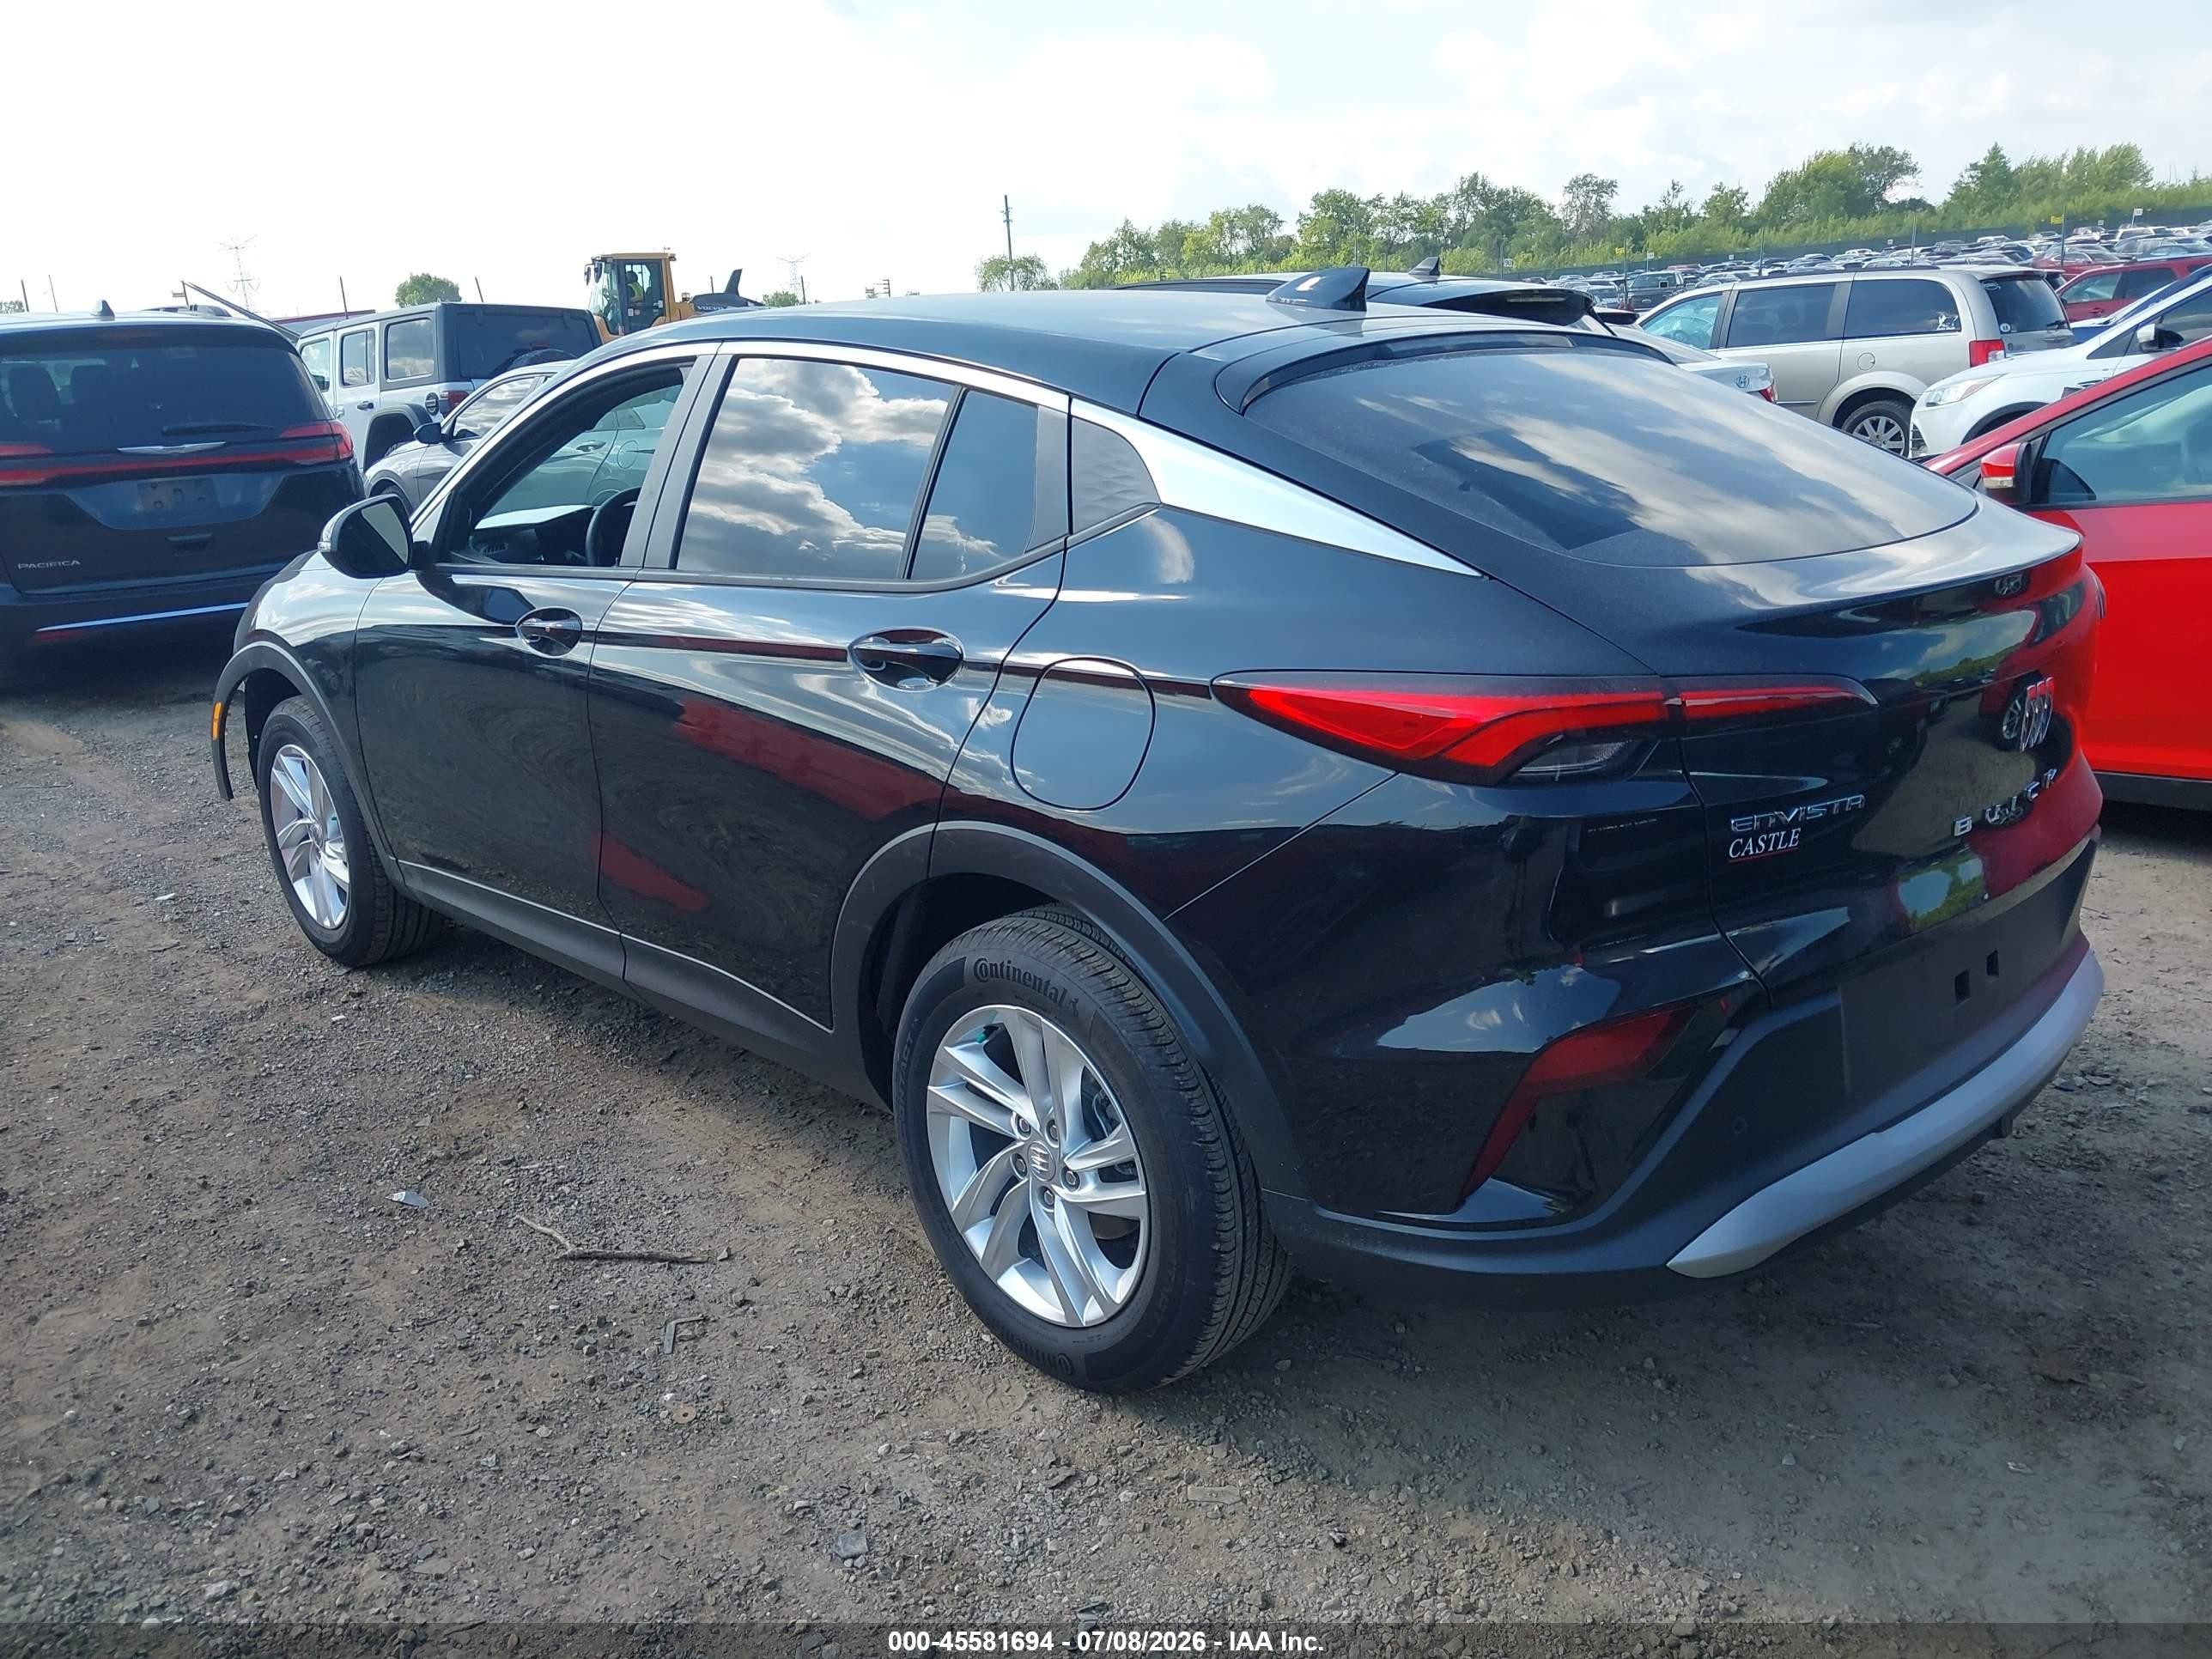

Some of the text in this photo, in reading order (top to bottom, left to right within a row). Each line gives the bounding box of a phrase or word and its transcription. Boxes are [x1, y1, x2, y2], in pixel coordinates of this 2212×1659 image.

[18, 560, 81, 569] PACIFICA
[1730, 794, 1866, 832] ENVISTA
[1729, 828, 1802, 859] CASTLE
[973, 957, 1068, 1007] Continental
